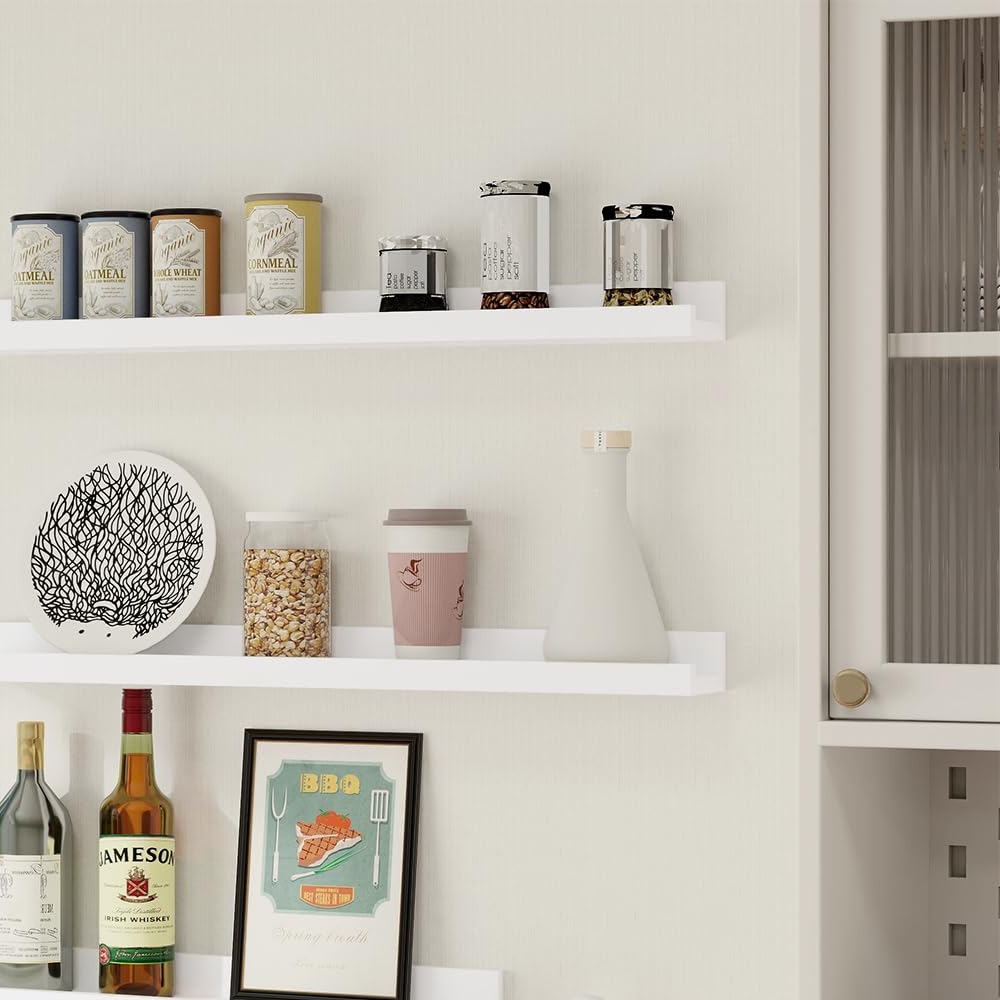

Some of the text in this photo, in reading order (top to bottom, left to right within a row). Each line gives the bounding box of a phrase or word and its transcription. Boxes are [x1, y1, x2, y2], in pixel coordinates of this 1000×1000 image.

[248, 257, 298, 269] CORNMEAL
[173, 268, 202, 277] WHEAT
[300, 772, 361, 795] BBQ
[99, 847, 174, 867] JAMESON
[130, 915, 171, 923] WHISKEY
